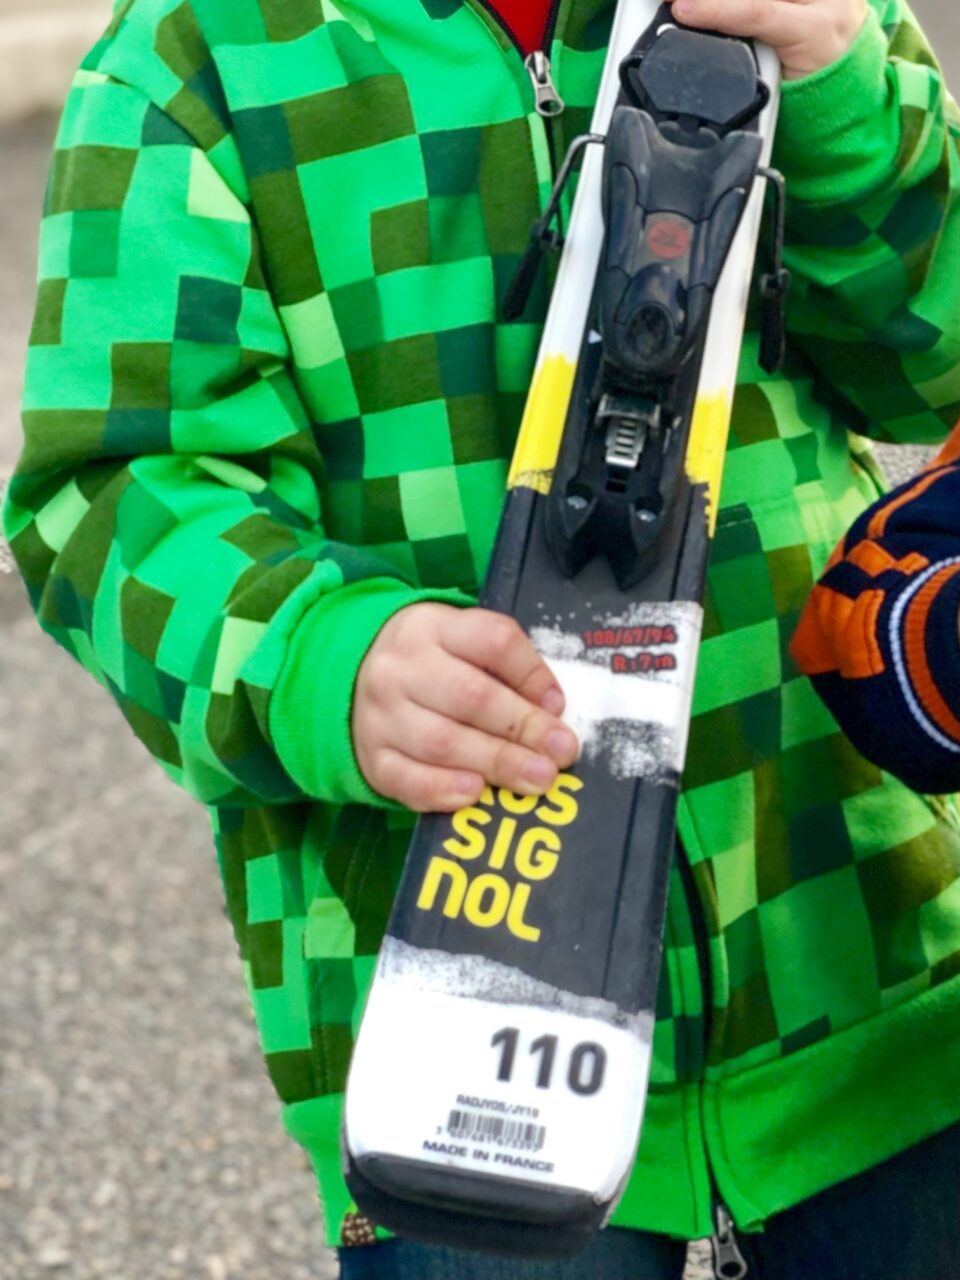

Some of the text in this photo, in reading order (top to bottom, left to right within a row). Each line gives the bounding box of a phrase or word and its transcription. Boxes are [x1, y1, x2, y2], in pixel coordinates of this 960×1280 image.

[442, 805, 562, 881] SIG
[490, 1026, 608, 1097] 110
[422, 1140, 555, 1173] MADE IN FRANCE
